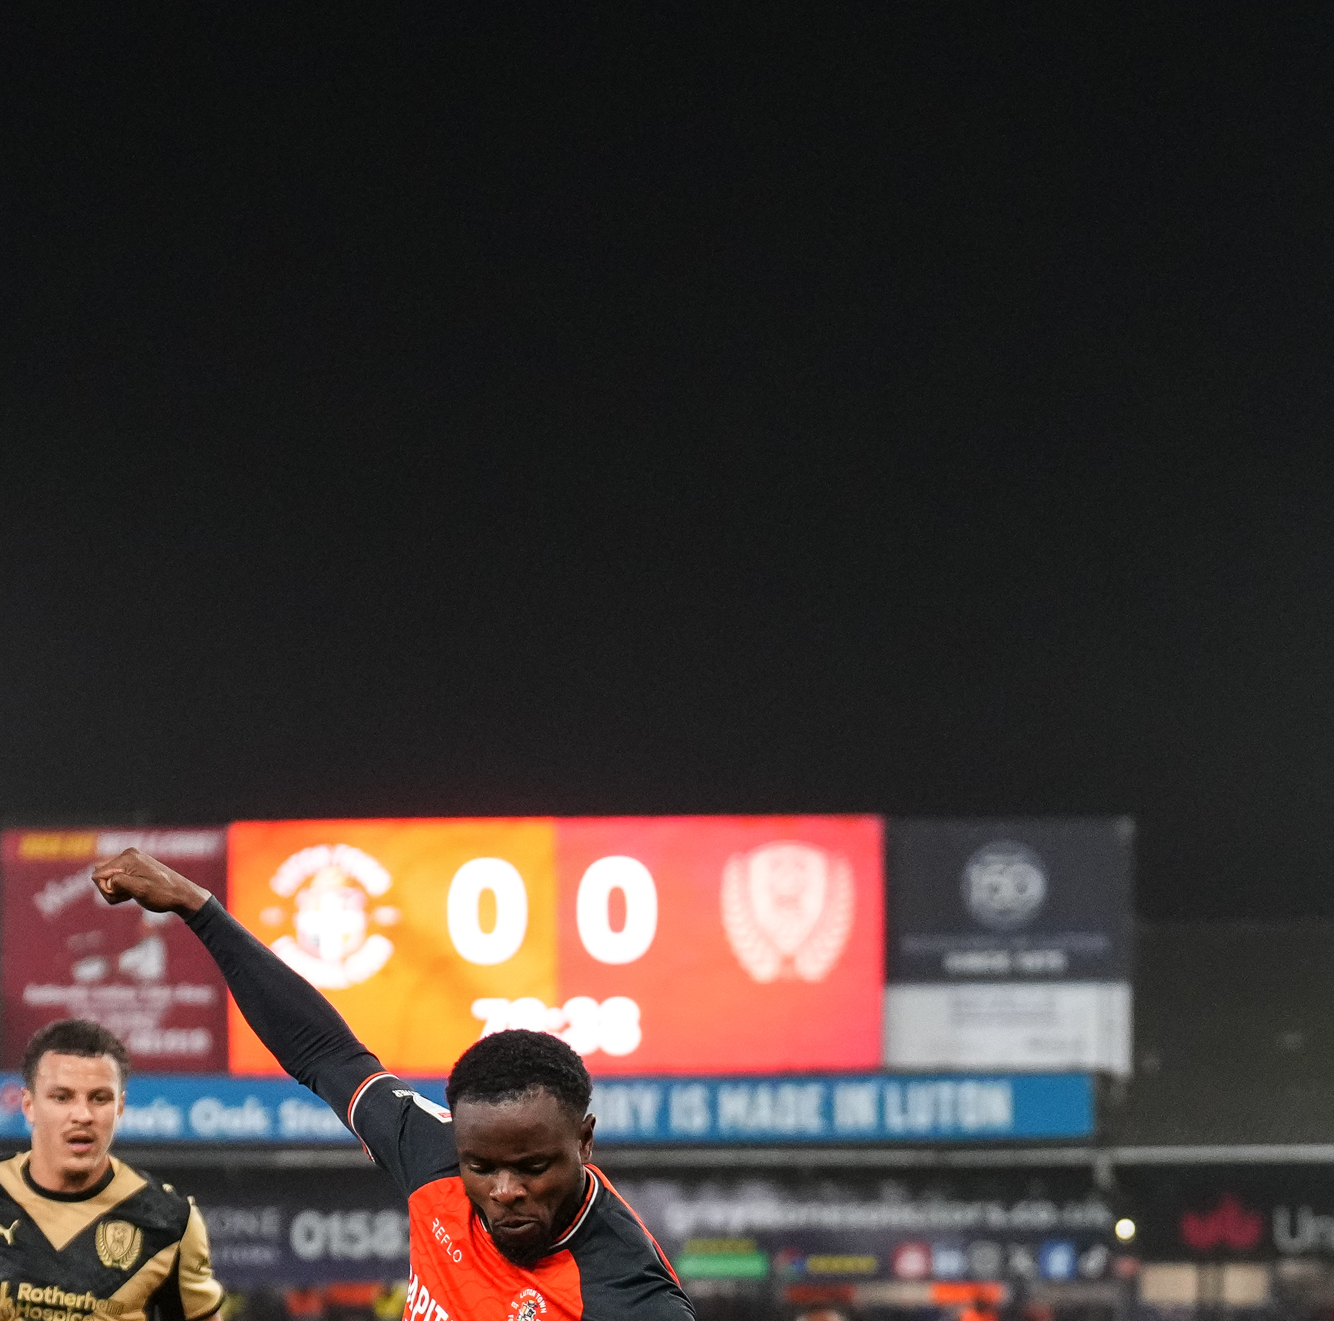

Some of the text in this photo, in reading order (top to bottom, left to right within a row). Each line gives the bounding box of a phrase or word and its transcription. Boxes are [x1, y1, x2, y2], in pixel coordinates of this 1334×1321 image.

[446, 856, 529, 966] 0
[576, 855, 659, 965] 0
[432, 1217, 463, 1264] REFLO
